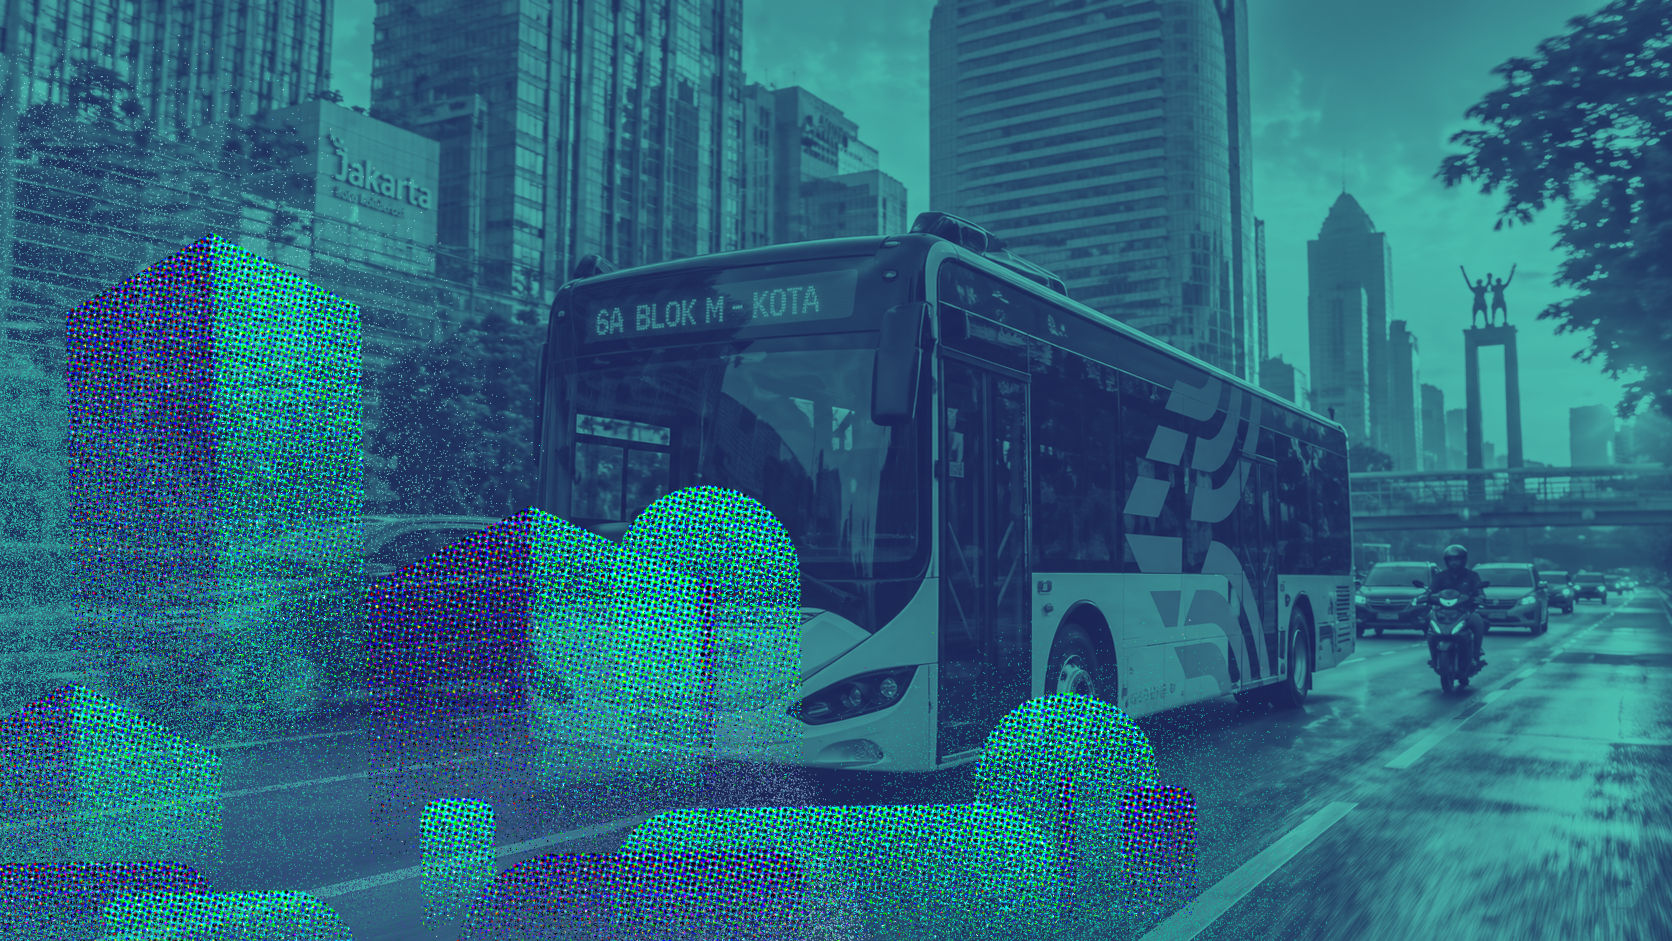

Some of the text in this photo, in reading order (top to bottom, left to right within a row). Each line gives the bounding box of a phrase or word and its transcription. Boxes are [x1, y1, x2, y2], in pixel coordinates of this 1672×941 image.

[596, 307, 625, 336] 6A
[636, 299, 697, 331] BLOK
[706, 296, 724, 324] M
[752, 285, 820, 319] KOTA
